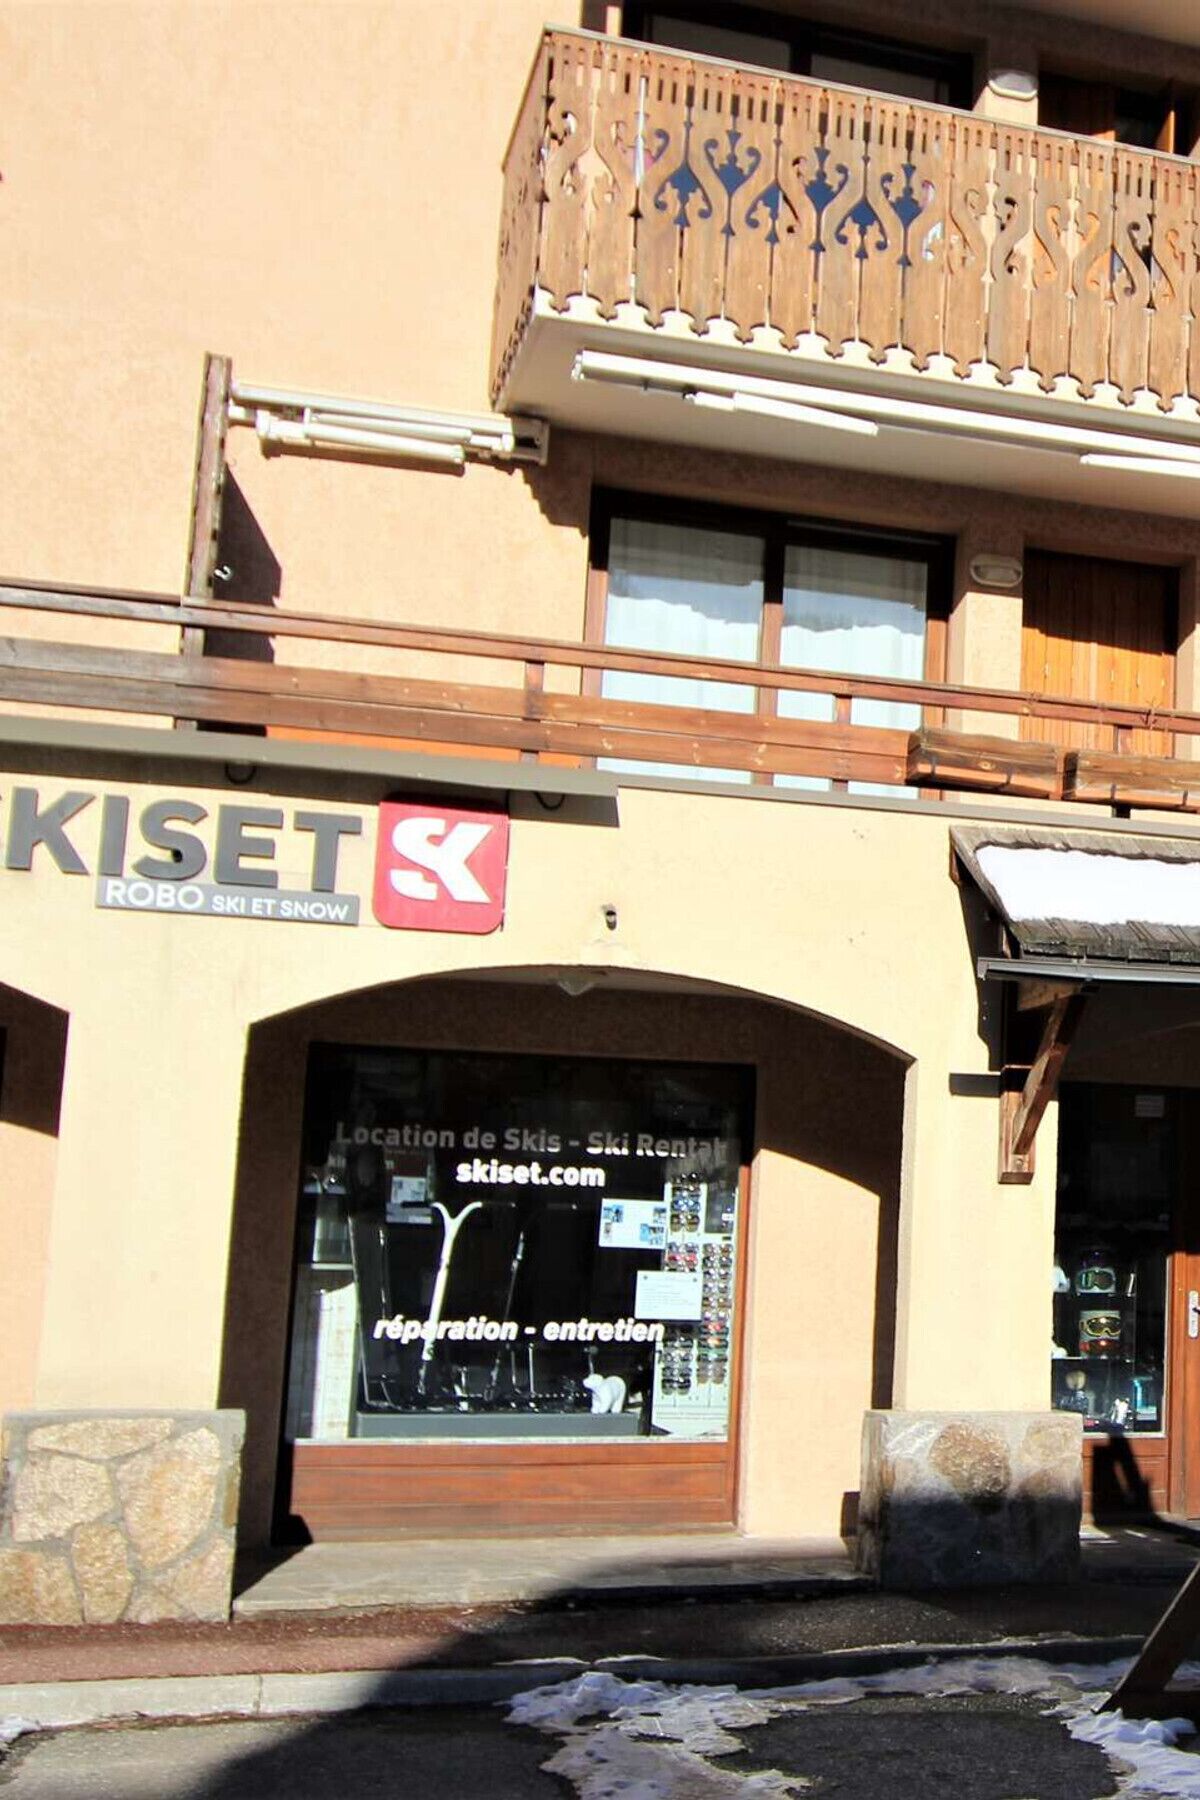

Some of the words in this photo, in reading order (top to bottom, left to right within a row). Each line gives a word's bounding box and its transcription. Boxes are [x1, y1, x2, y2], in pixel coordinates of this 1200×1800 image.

[0, 787, 361, 893] KISET
[106, 879, 205, 910] ROBO
[212, 895, 247, 914] SKI
[251, 899, 277, 916] ET
[280, 902, 349, 921] SNOW
[336, 1122, 455, 1147] Location
[463, 1126, 496, 1149] de
[504, 1128, 561, 1152] Skis
[587, 1131, 629, 1156] Ski
[456, 1158, 606, 1187] skiset.com
[373, 1315, 519, 1344] réparation
[543, 1317, 665, 1342] entretien
